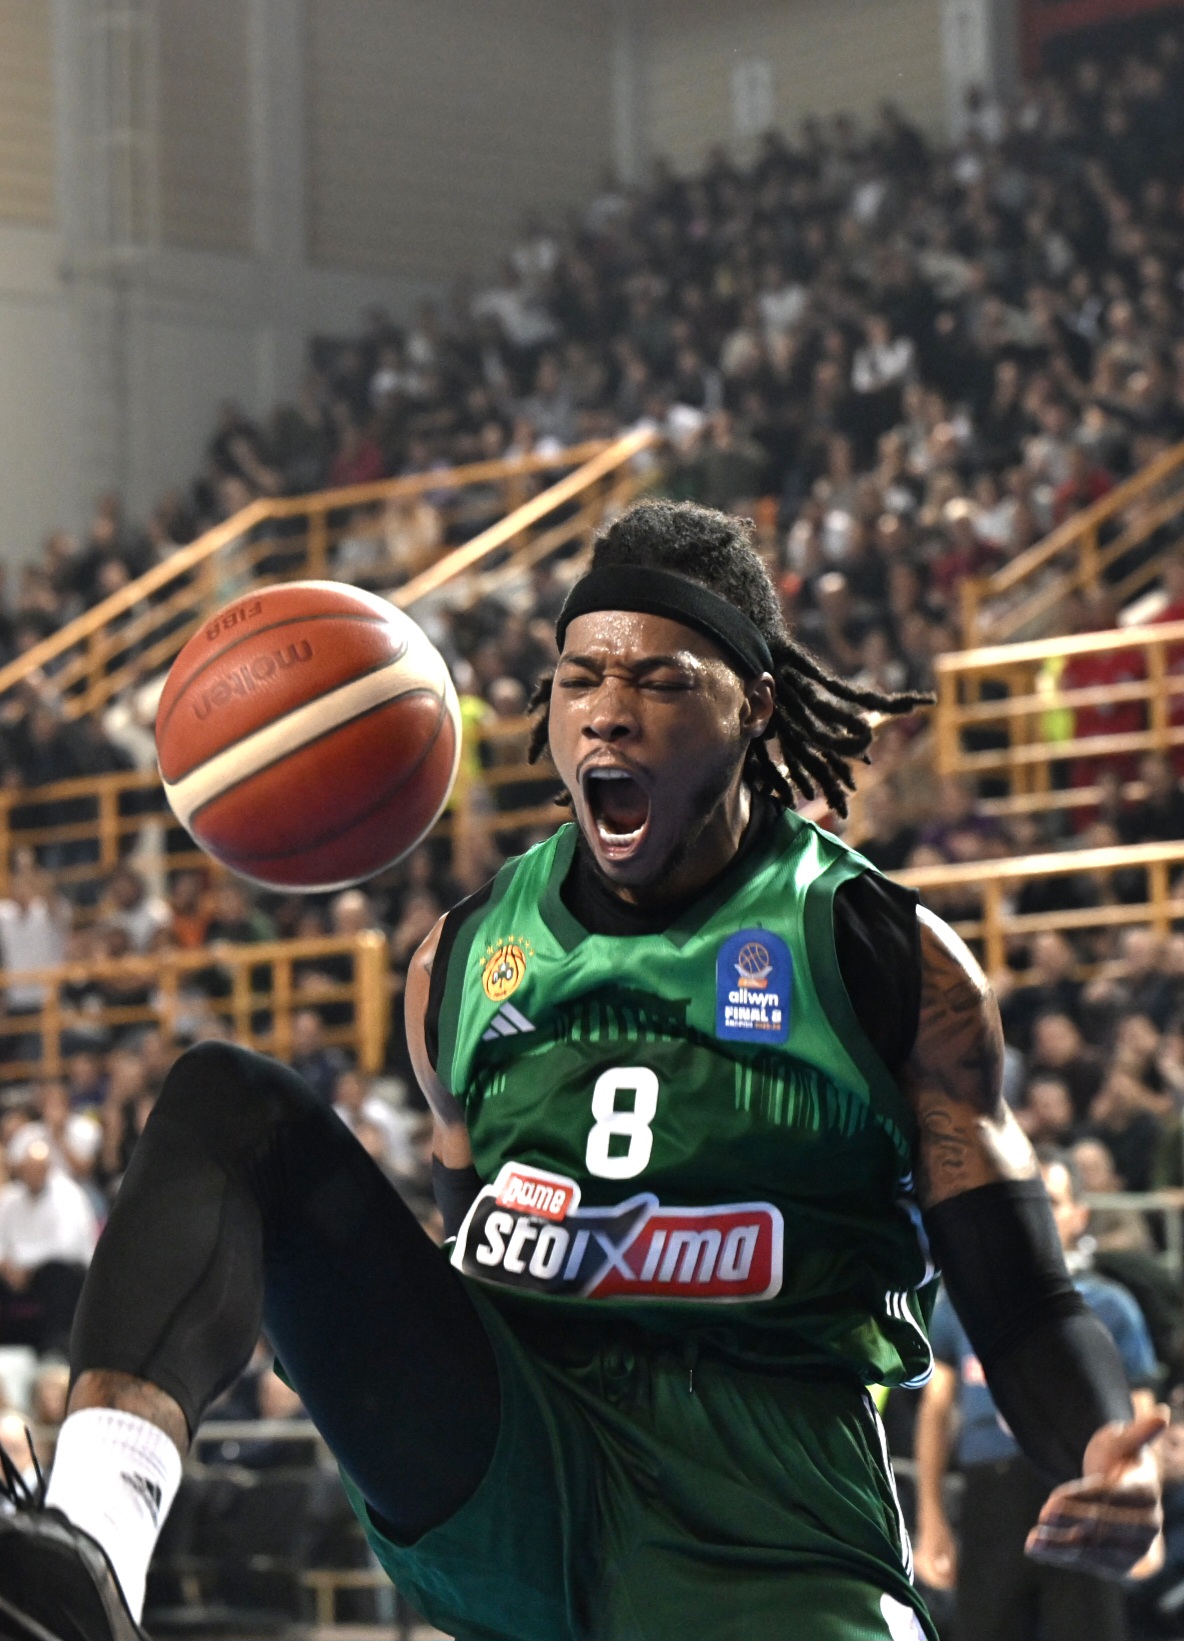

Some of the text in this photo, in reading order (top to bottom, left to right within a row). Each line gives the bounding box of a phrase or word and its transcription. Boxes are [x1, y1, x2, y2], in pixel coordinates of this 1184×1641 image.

[205, 601, 263, 642] FIBA
[191, 639, 314, 721] molten
[725, 1005, 769, 1023] FINAL
[728, 988, 779, 1008] allwyn
[585, 1066, 660, 1180] 8
[501, 1177, 566, 1214] pame
